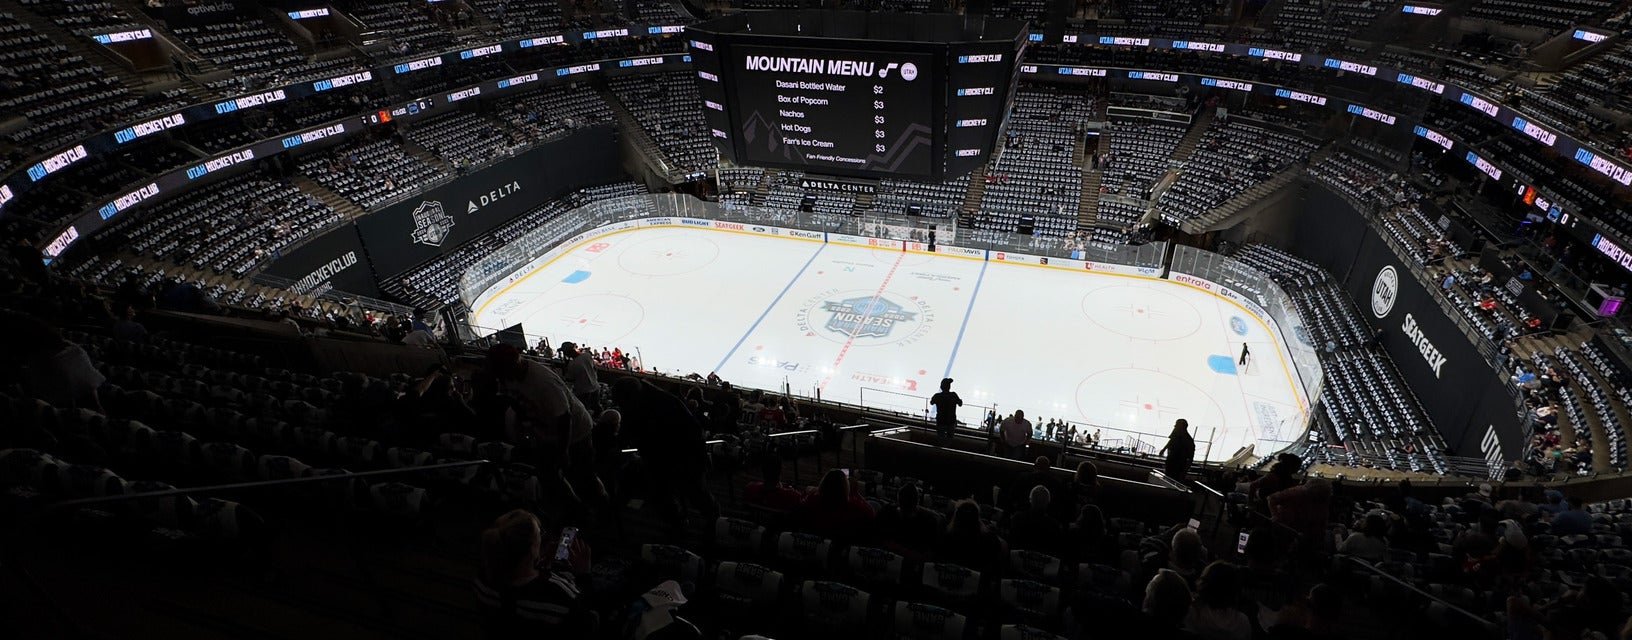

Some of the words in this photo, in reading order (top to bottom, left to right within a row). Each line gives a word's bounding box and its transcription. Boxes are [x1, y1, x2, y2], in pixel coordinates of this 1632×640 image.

[1029, 34, 1044, 42] UTAH
[1063, 35, 1078, 43] CLUB
[1114, 37, 1136, 46] HOCKEY
[1135, 38, 1150, 46] CLUB
[1173, 40, 1188, 48] UTAH
[1188, 41, 1210, 51] HOCKEY
[1209, 44, 1225, 52] CLUB
[968, 54, 989, 63] HOCKEY
[1264, 49, 1287, 60] HOCKEY
[1286, 52, 1301, 61] CLUB
[746, 55, 824, 74] MOUNTAIN
[827, 60, 875, 77] MENU
[1340, 61, 1363, 72] HOCKEY
[1361, 64, 1377, 75] CLUB
[1072, 68, 1093, 76] HOCKEY
[1092, 69, 1107, 77] CLUB
[1142, 72, 1165, 81] HOCKEY
[1163, 74, 1179, 82] CLUB
[331, 75, 356, 88] HOCKEY
[355, 71, 372, 81] CLUB
[1215, 79, 1238, 90] HOCKEY
[1237, 82, 1253, 92] CLUB
[776, 80, 799, 89] Dasani
[800, 82, 824, 90] Bottled
[825, 83, 846, 92] Water
[873, 85, 884, 94] $2
[965, 88, 985, 96] HOCKEY
[215, 100, 238, 114] UTAH
[236, 93, 266, 109] HOCKEY
[265, 89, 286, 102] CLUB
[777, 95, 791, 103] Box
[792, 95, 800, 104] of
[801, 96, 829, 106] Popcorn
[1290, 91, 1312, 103] HOCKEY
[1310, 96, 1327, 106] CLUB
[874, 101, 884, 110] $3
[779, 110, 805, 118] Nachos
[874, 115, 885, 125] $3
[114, 128, 136, 144] UTAH
[133, 116, 165, 137] HOCKEY
[163, 114, 186, 128] CLUB
[781, 123, 794, 131] Hot
[794, 124, 812, 134] Dogs
[962, 119, 981, 127] HOCKEY
[282, 135, 302, 148] UTAH
[301, 128, 328, 143] HOCKEY
[327, 124, 345, 138] CLUB
[875, 130, 885, 139] $3
[801, 138, 812, 147] Ice
[812, 139, 834, 148] Cream
[875, 143, 886, 153] $3
[42, 151, 71, 174] HOCKEY
[66, 144, 88, 162] CLUB
[186, 164, 207, 180] UTAH
[205, 156, 235, 173] HOCKEY
[234, 149, 254, 163] CLUB
[835, 156, 866, 164] Concessions
[1574, 147, 1594, 165] UTAH
[1590, 154, 1617, 177] HOCKEY
[810, 181, 839, 190] DELTA
[841, 184, 874, 193] CENTER
[480, 181, 521, 207] DELTA
[99, 202, 118, 220] UTAH
[114, 190, 142, 211] HOCKEY
[140, 183, 160, 199] CLUB
[417, 212, 445, 230] SEASON
[714, 222, 745, 231] SEATGEEK
[1596, 236, 1626, 263] HOCKEY
[515, 265, 535, 280] DELTA
[1176, 275, 1211, 290] entrata
[1376, 278, 1393, 308] UTAH
[833, 312, 893, 328] SEASON
[1401, 313, 1447, 379] SEATGEEK
